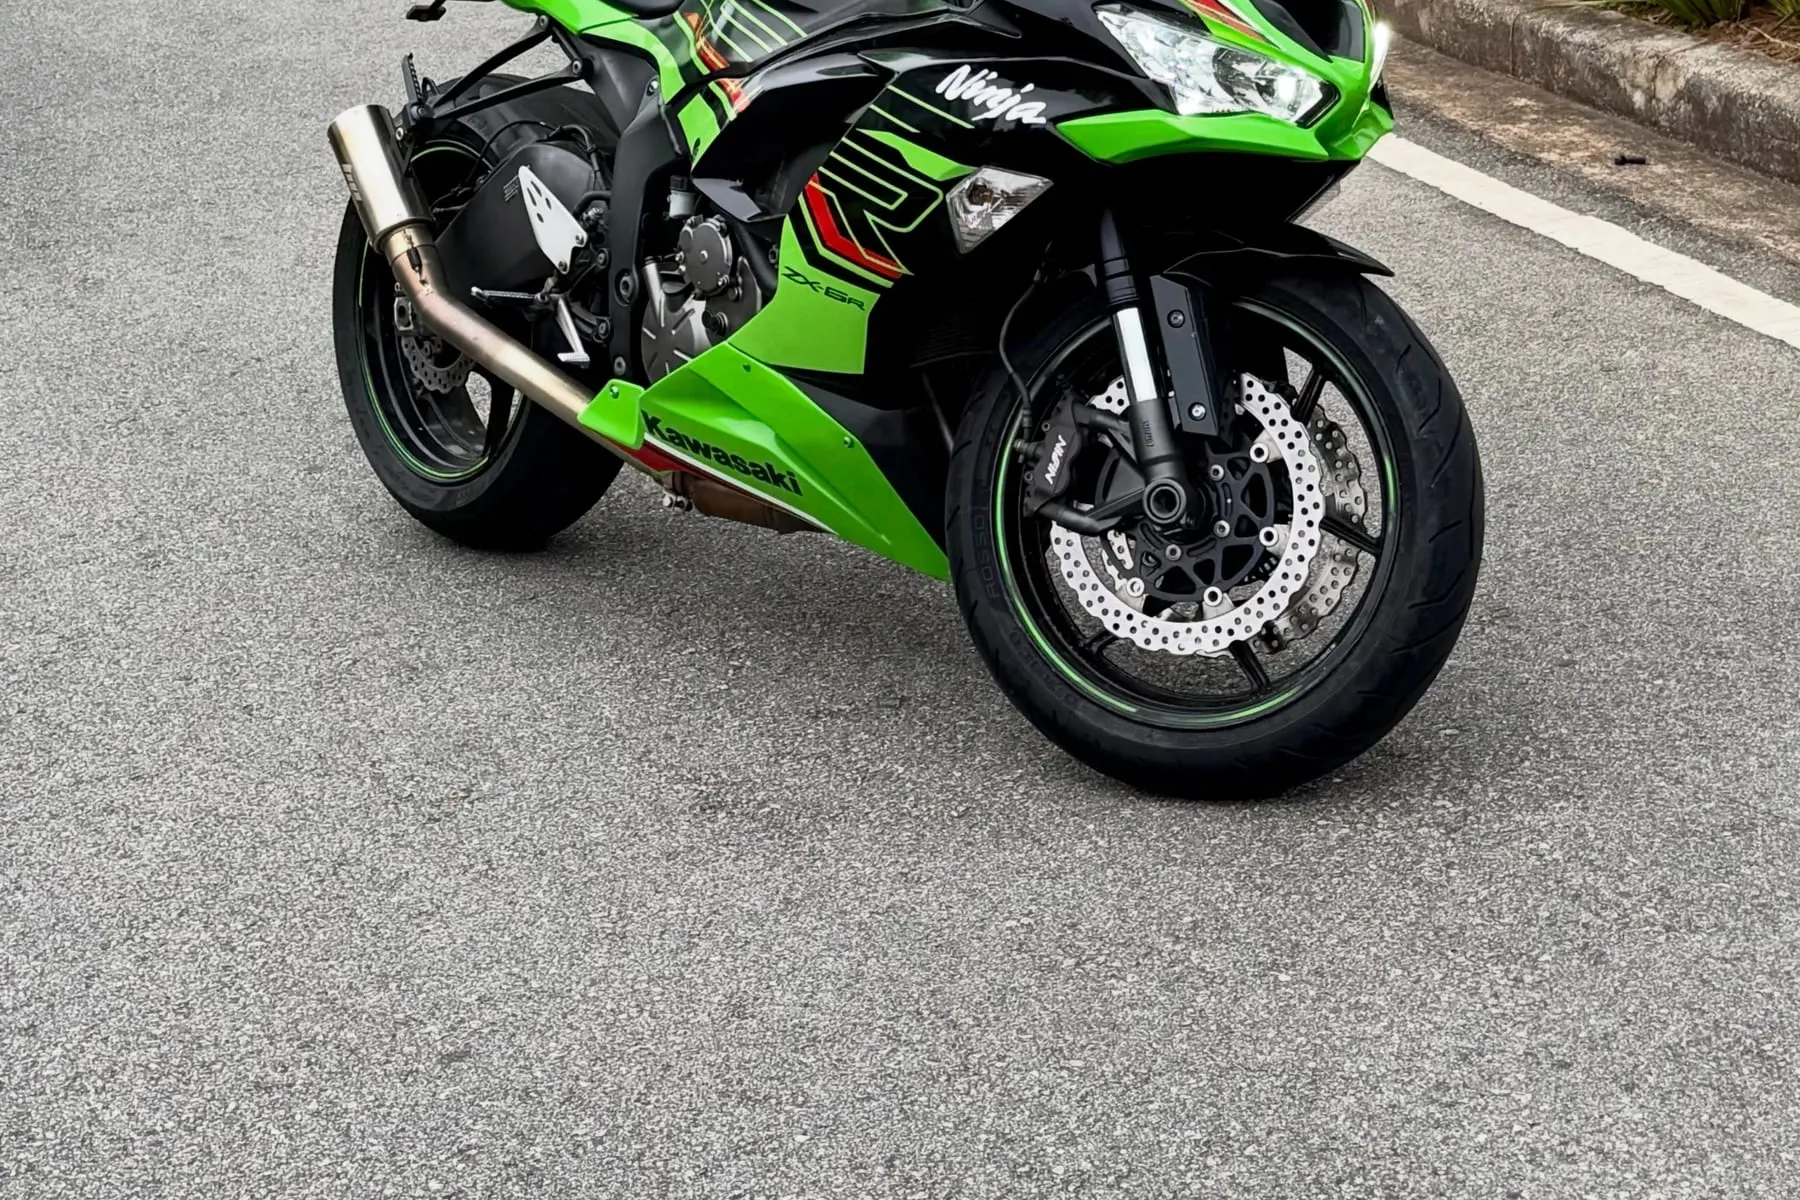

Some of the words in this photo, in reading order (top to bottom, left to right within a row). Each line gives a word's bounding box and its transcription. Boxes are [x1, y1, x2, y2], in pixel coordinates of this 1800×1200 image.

[935, 64, 1047, 124] Ninja
[781, 265, 866, 311] ZX-6R
[641, 409, 803, 496] Kawasaki
